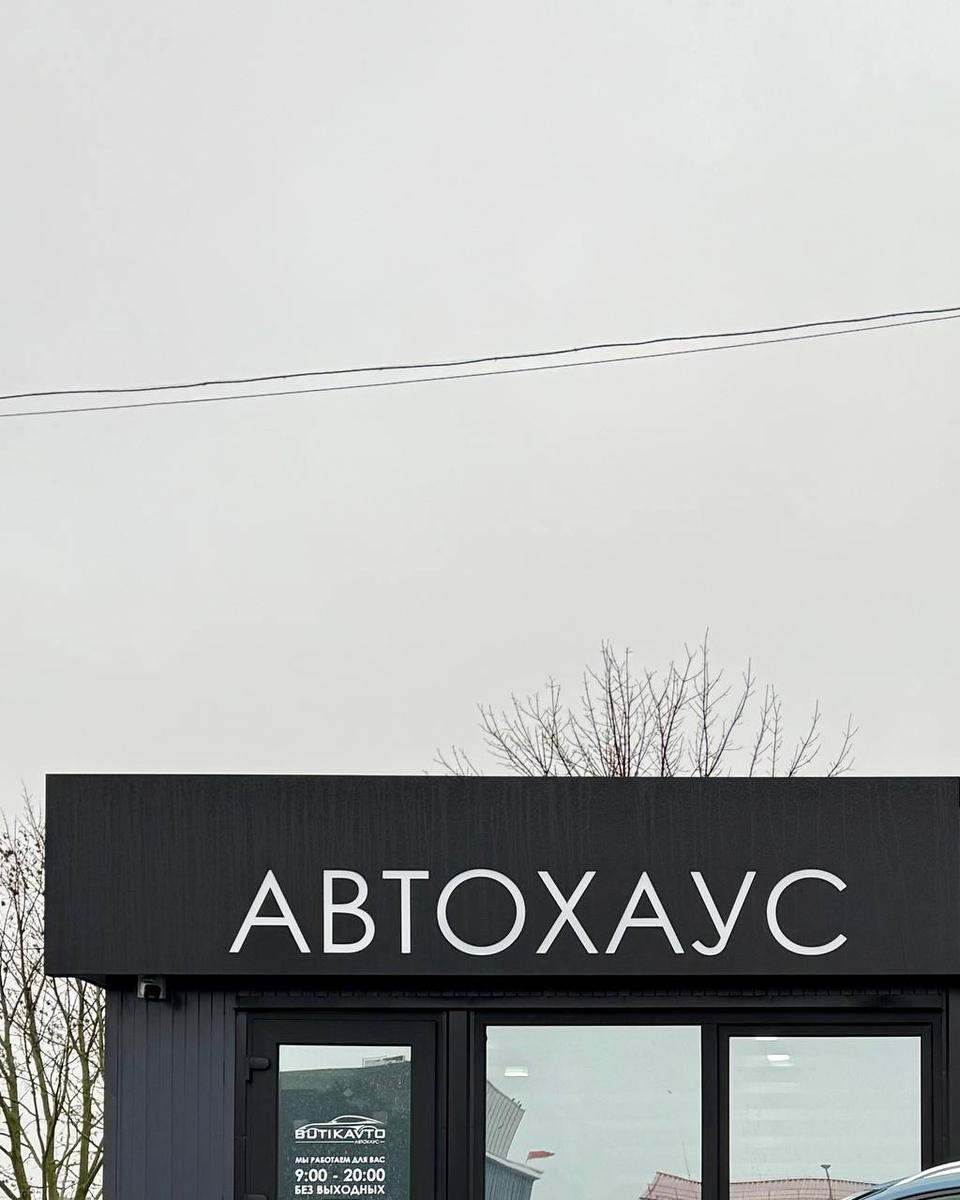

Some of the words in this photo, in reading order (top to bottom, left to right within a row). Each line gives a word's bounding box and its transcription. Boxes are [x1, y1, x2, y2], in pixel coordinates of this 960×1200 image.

[229, 869, 848, 956] АВТОХАУС
[295, 1128, 386, 1139] BUTIKAVTO
[295, 1156, 309, 1164] МЫ
[310, 1156, 350, 1164] РАБОТАЕМ
[351, 1156, 368, 1164] ДЛЯ
[369, 1156, 386, 1164] ВАС
[295, 1168, 328, 1182] 9:00
[343, 1168, 386, 1182] 20:00
[294, 1185, 314, 1195] БЕЗ
[316, 1184, 386, 1196] ВЫХОДНЫХ
